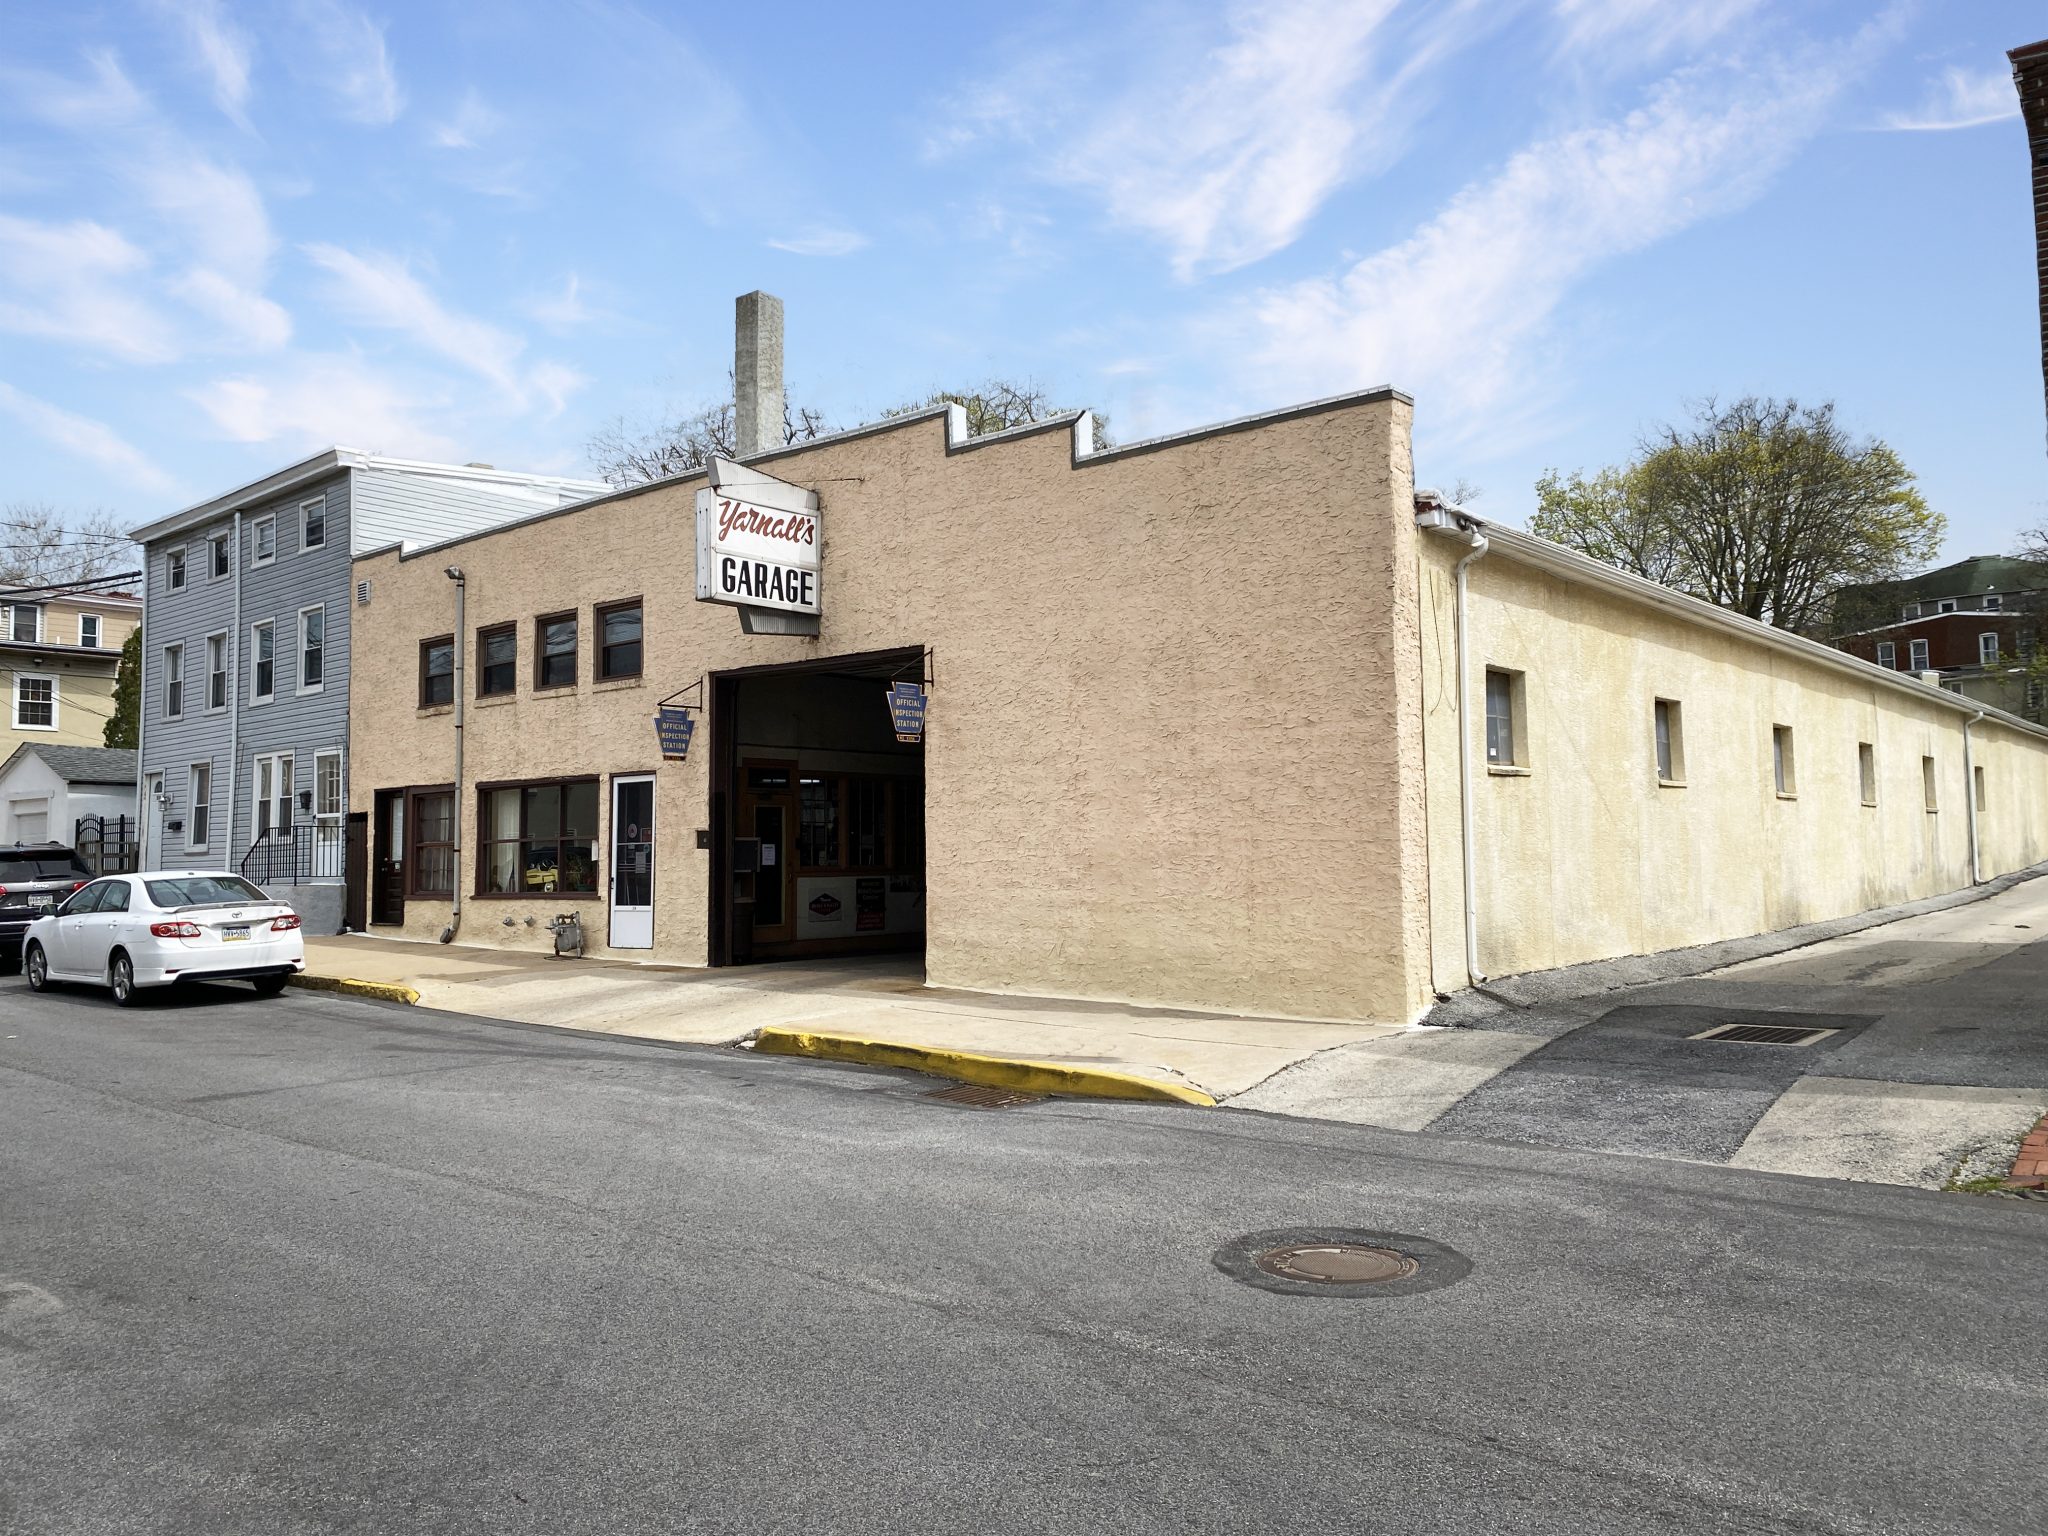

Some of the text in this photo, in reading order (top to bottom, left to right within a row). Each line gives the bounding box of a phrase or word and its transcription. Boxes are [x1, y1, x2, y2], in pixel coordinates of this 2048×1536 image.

[718, 500, 815, 546] Yarnall's
[722, 557, 813, 606] GARAGE
[896, 699, 920, 707] OFFICIAL
[895, 709, 923, 718] INSPECTION
[896, 719, 919, 728] STATION
